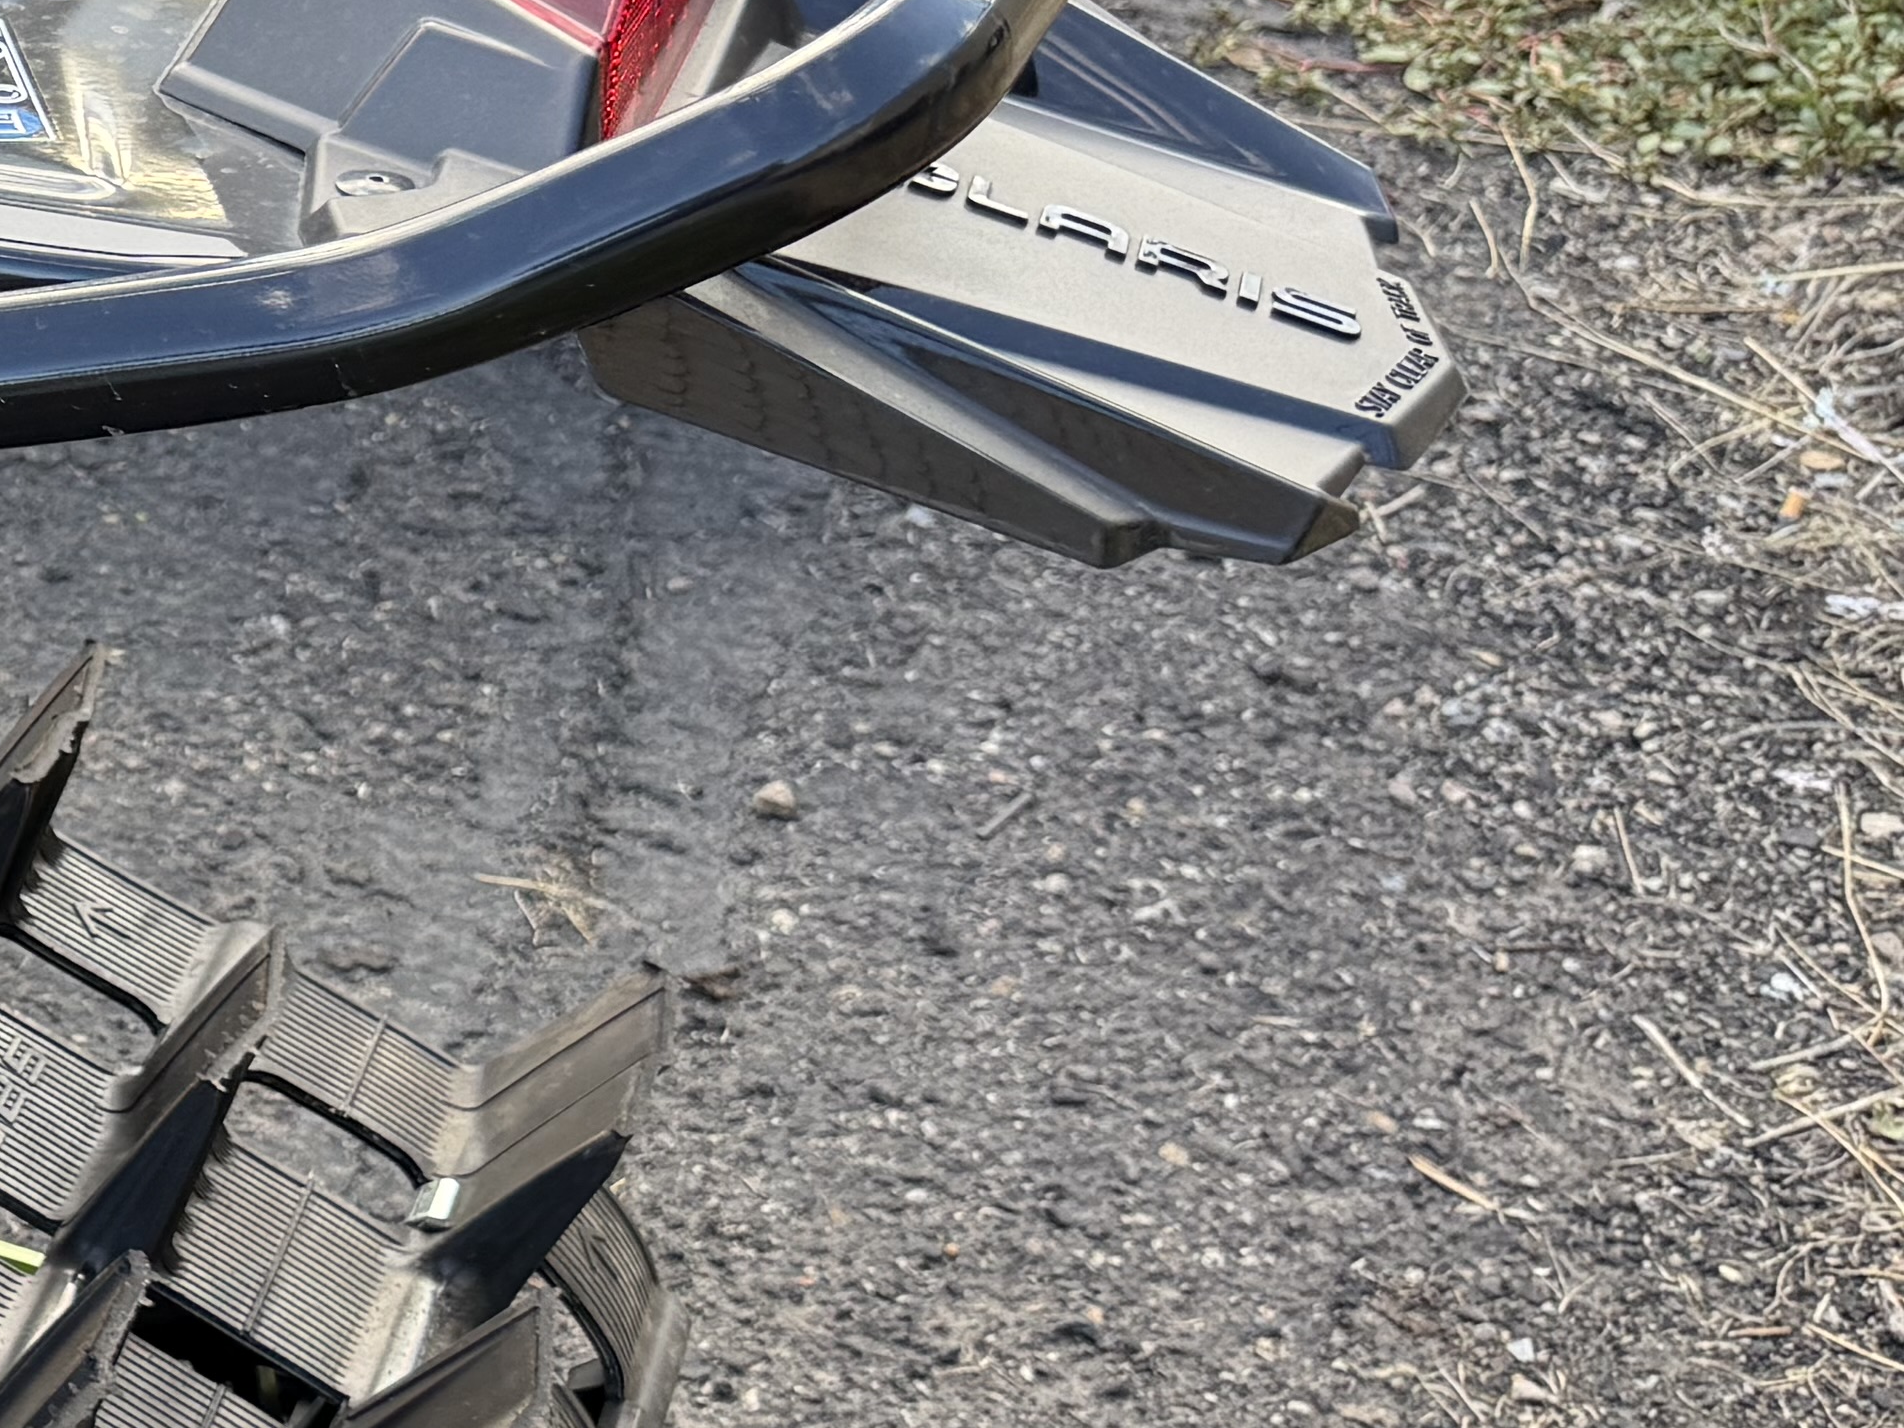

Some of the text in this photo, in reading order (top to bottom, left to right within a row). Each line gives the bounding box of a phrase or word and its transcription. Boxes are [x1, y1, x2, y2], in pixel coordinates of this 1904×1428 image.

[1355, 277, 1439, 418] STAY CLEAR OF TRACK
